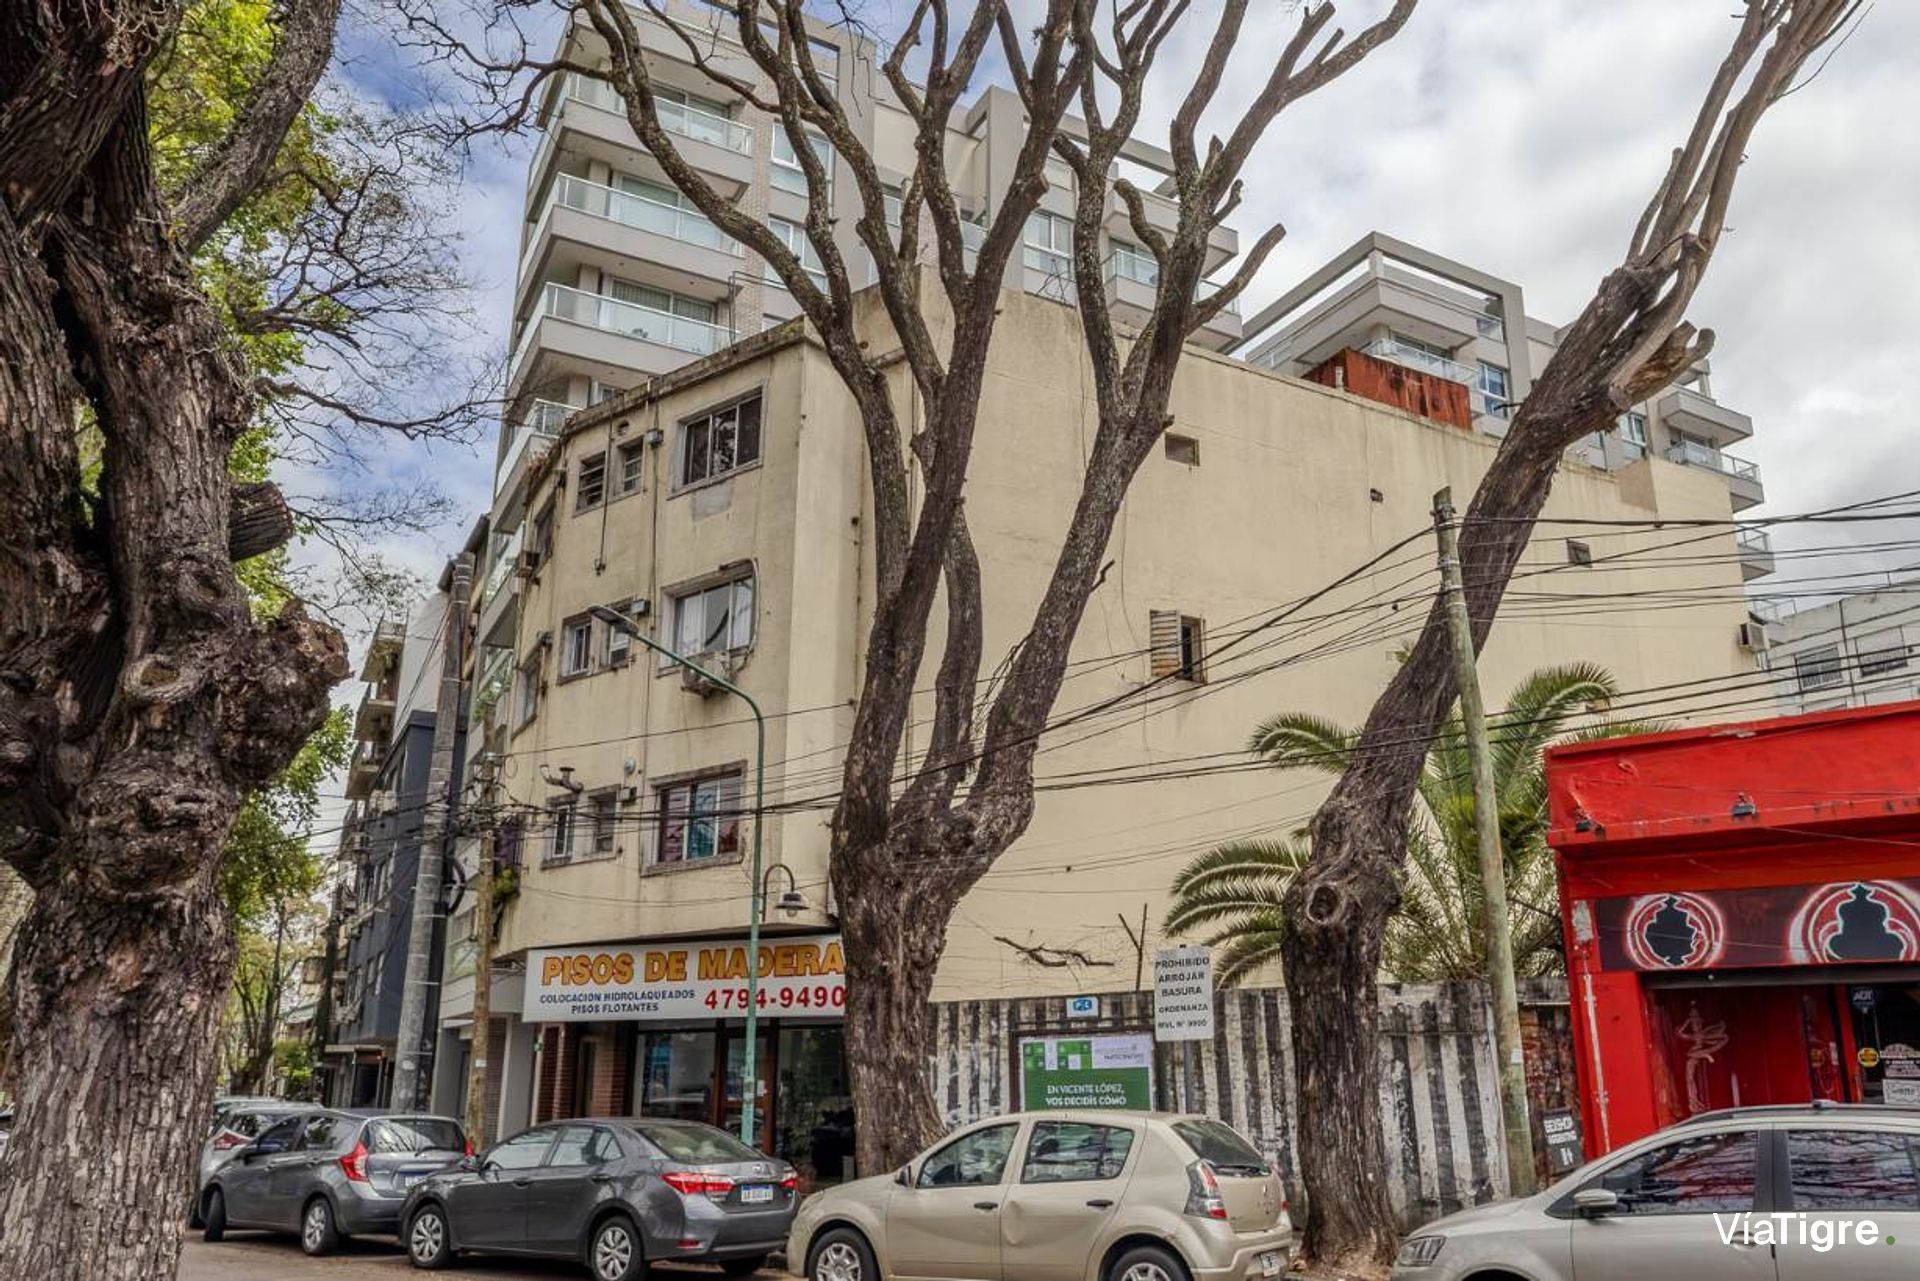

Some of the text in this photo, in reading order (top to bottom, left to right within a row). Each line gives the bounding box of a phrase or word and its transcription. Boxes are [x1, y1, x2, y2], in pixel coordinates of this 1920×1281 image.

[541, 943, 845, 986] PISOS DE MADERA
[1155, 956, 1210, 968] PROHIBIDO
[1158, 971, 1205, 983] ARROJAR
[604, 989, 695, 1001] HIDROLAQUEADOS
[704, 985, 846, 1010] 4794-9490
[1161, 986, 1202, 997] BASURA
[571, 1002, 659, 1014] PISOS FLOTANTES
[1158, 1003, 1209, 1014] ORDENANZA
[1060, 1084, 1094, 1094] VICENTE
[1046, 1097, 1064, 1105] VOS
